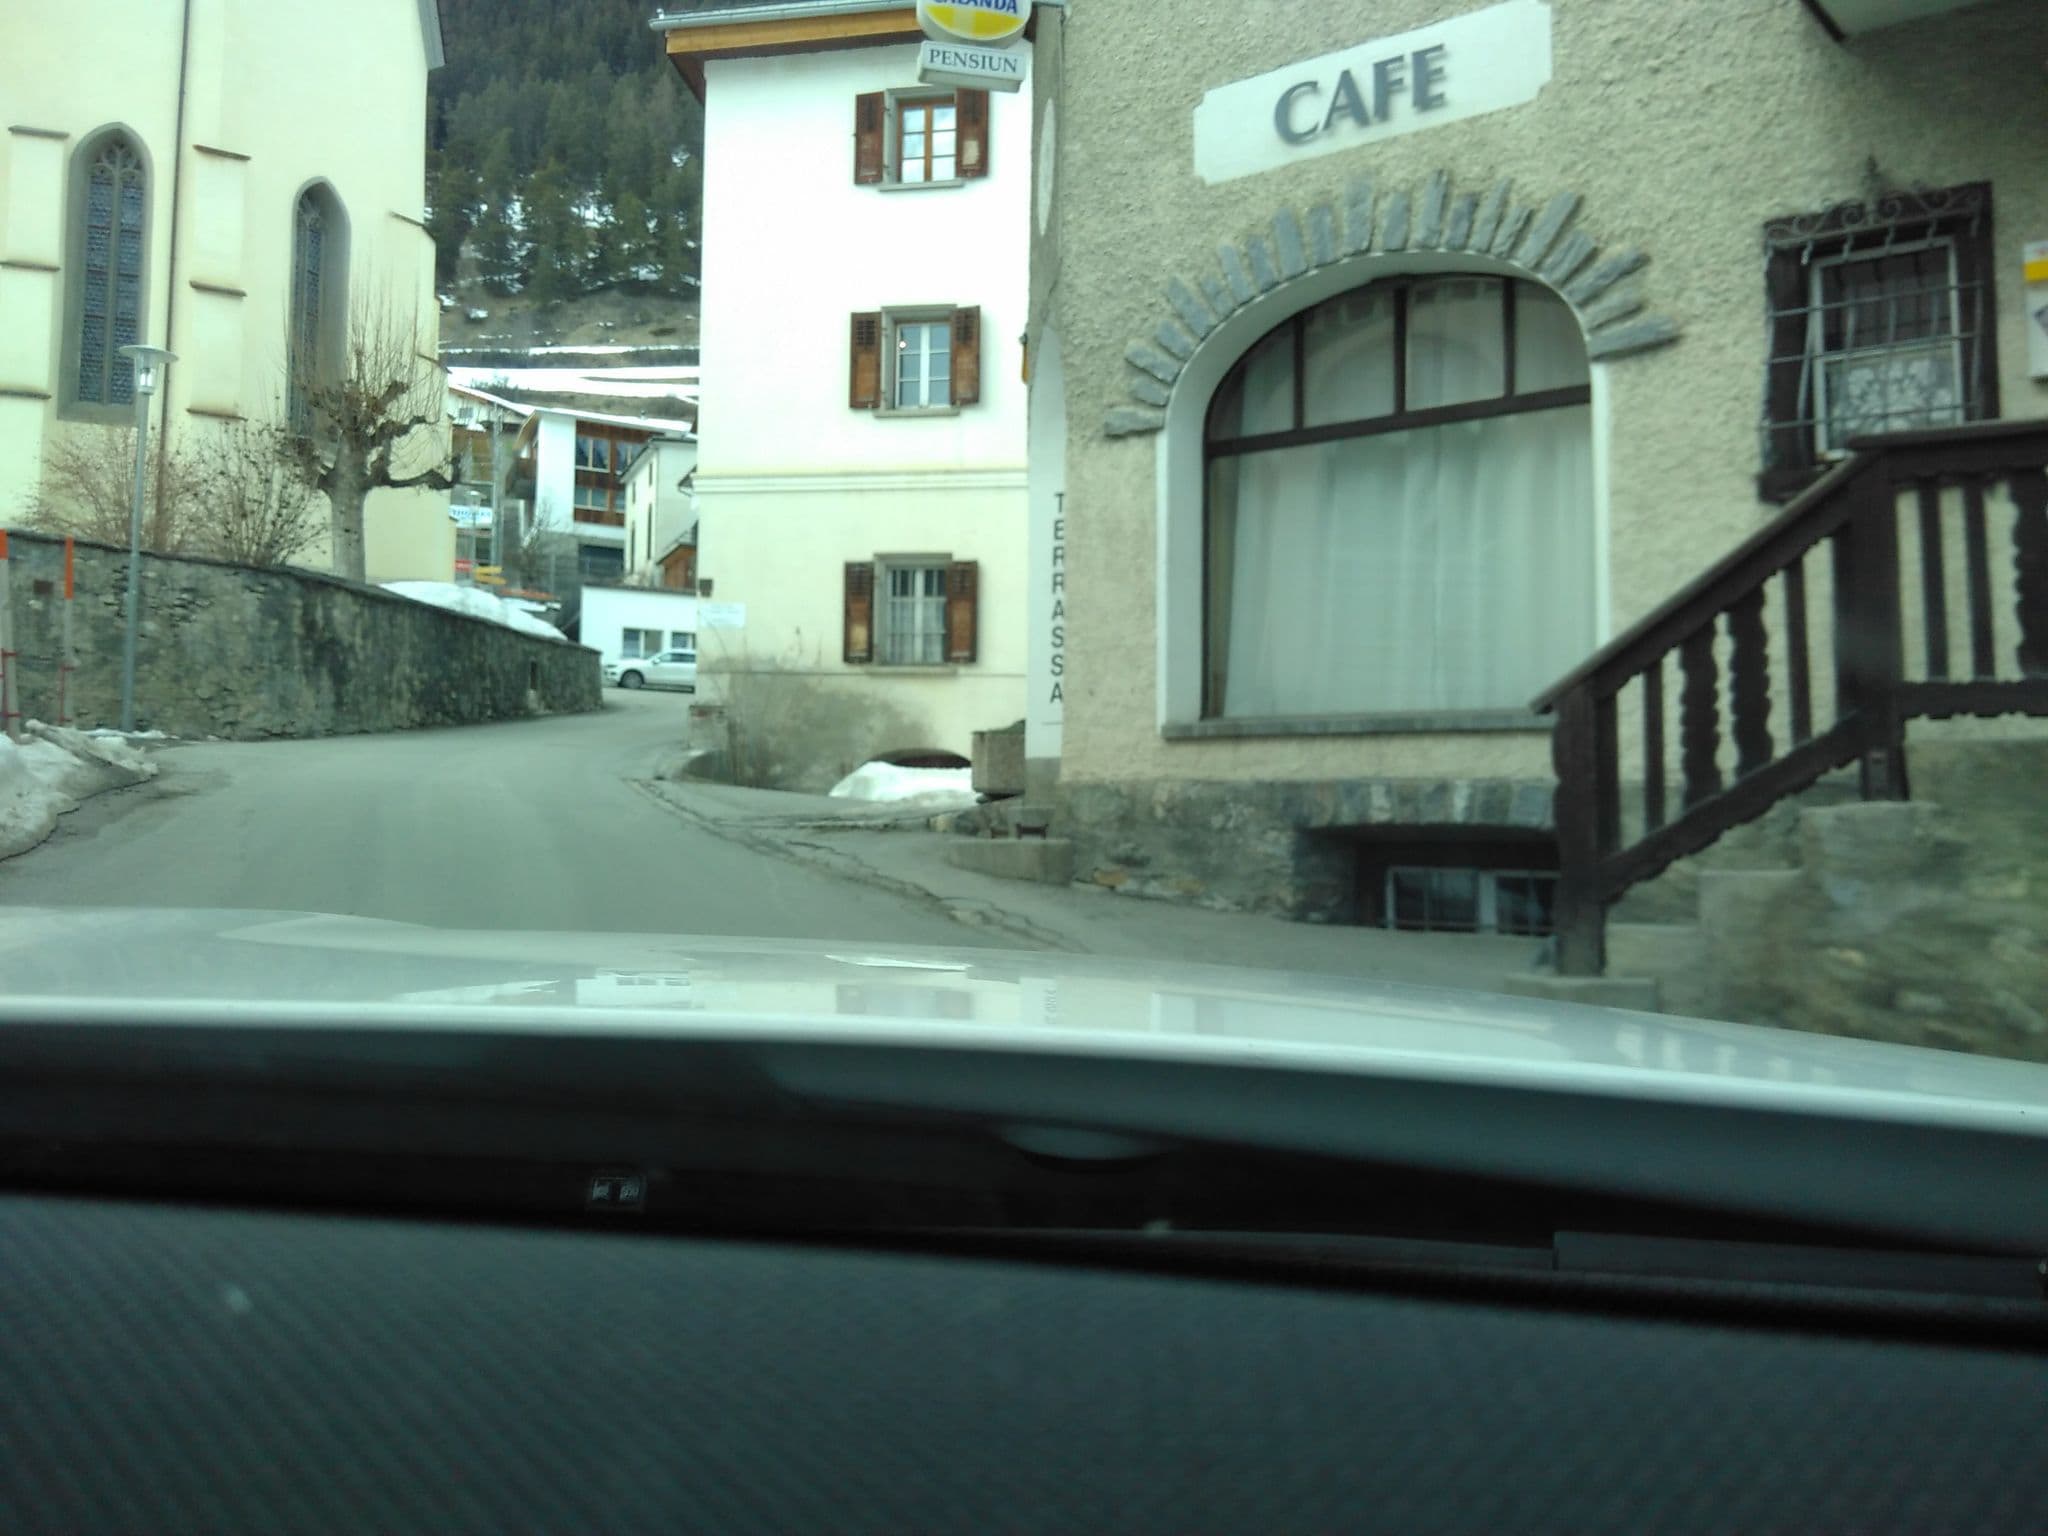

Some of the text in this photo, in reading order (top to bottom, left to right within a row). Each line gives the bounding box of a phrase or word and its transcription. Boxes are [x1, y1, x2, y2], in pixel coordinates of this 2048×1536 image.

[934, 0, 1017, 14] ANDA
[929, 48, 1019, 73] PENSIUN
[1273, 43, 1446, 146] CAFE
[1050, 492, 1066, 704] TERRASSA
